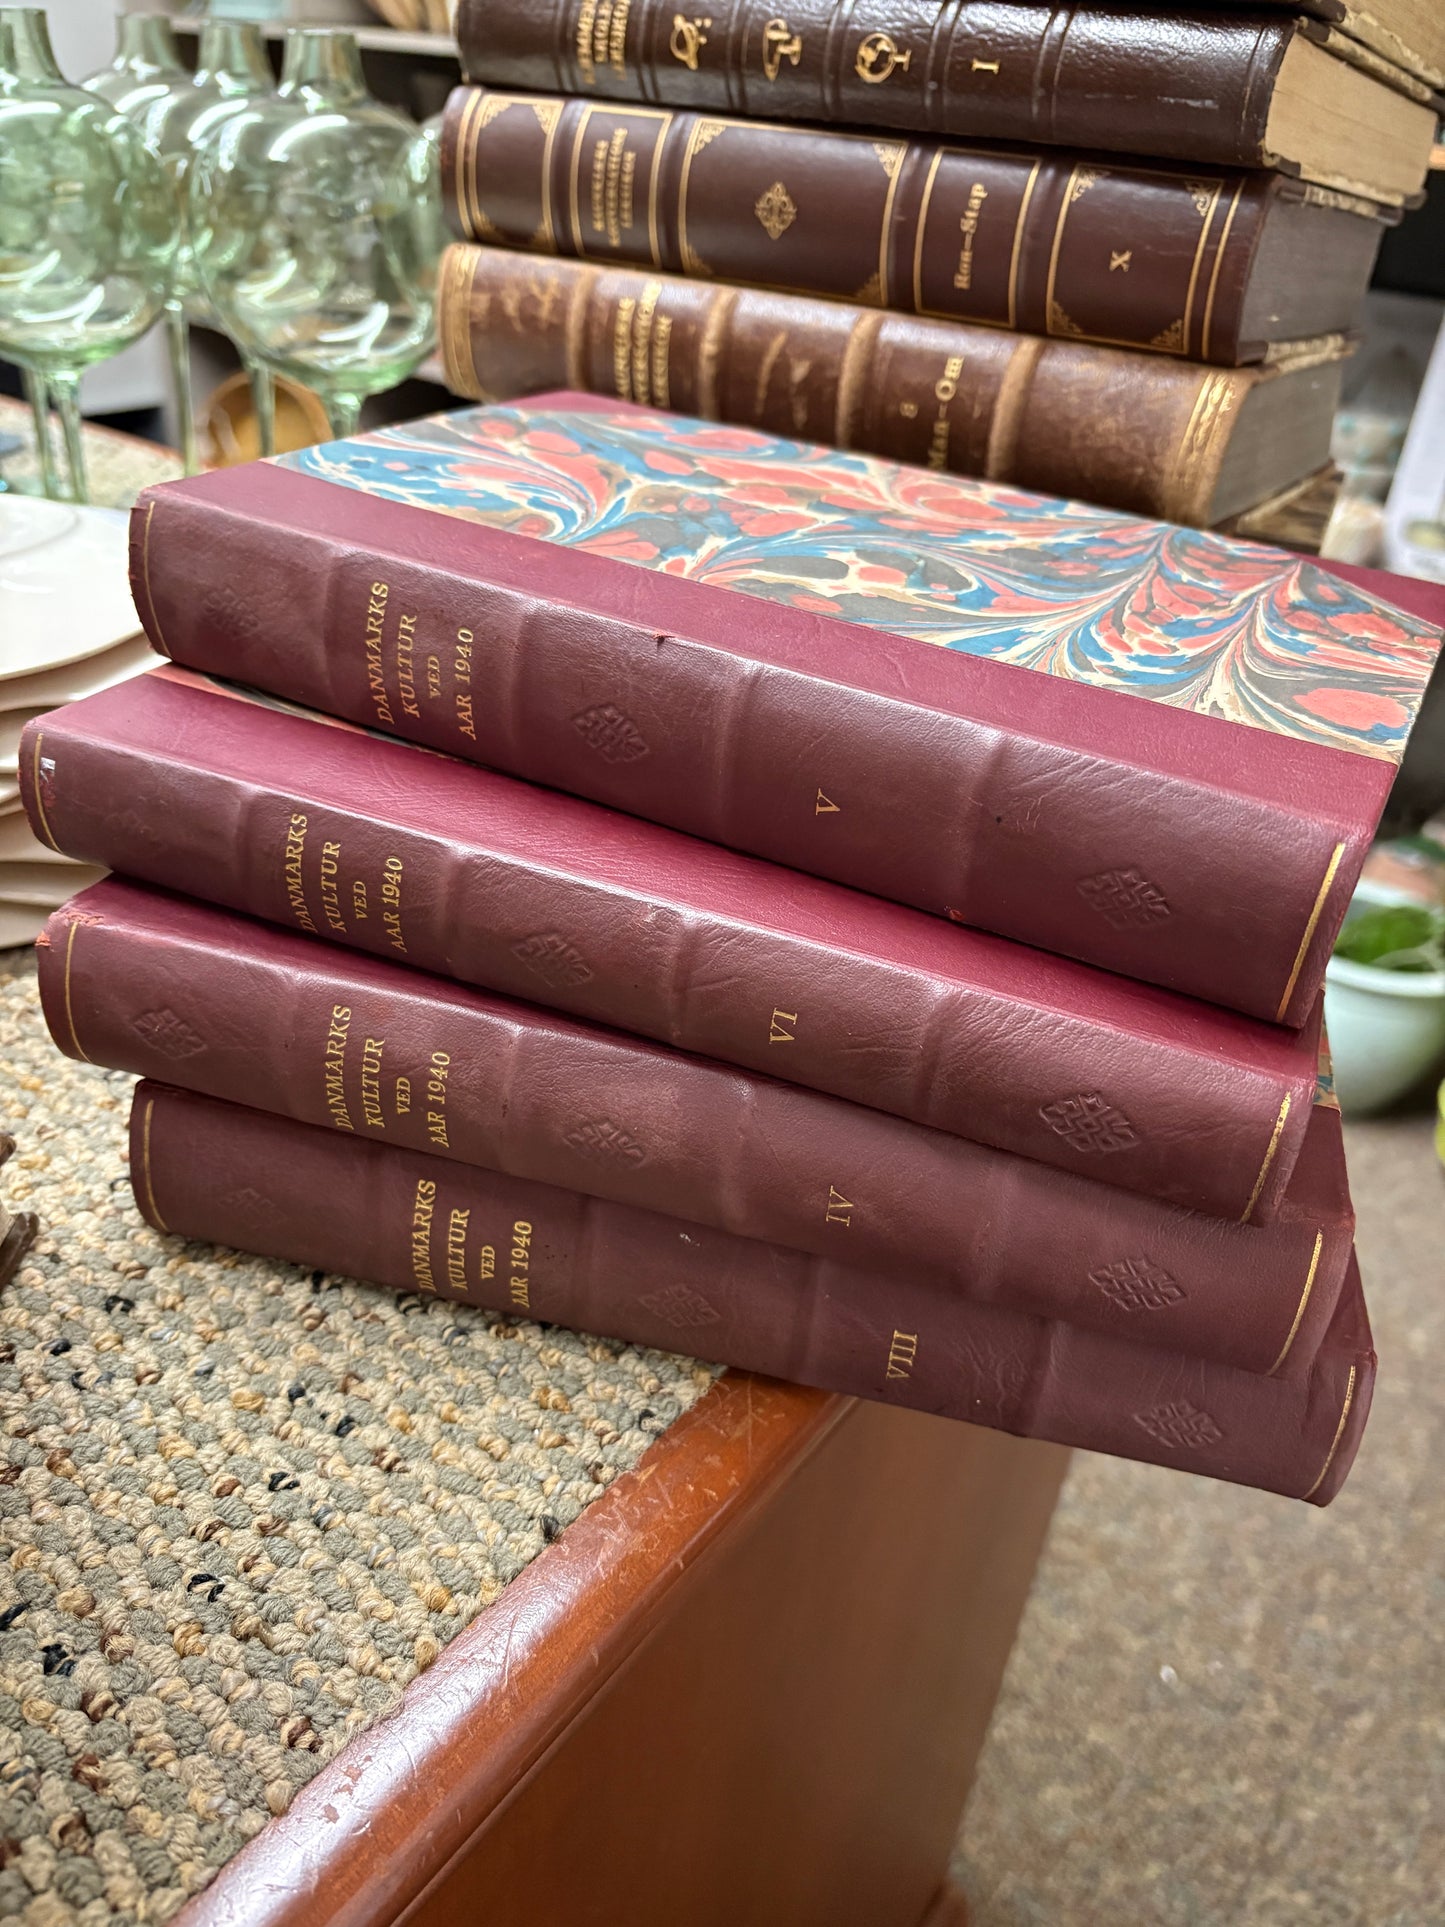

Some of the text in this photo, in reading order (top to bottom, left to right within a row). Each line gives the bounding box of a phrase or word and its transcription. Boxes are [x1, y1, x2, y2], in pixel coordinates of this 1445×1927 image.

[971, 58, 1000, 74] I
[365, 582, 395, 725] DANMARKS
[397, 614, 421, 719] KULTUR
[427, 654, 442, 700] VED
[454, 626, 477, 741] AAR 1940
[815, 787, 841, 816] V
[285, 813, 319, 934] DANMARKS
[320, 841, 348, 934] KULTUR
[353, 880, 369, 921] VED
[381, 856, 408, 954] AAR 1940
[324, 1004, 355, 1131] DANMARKS
[769, 1007, 798, 1045] VI
[361, 1037, 386, 1129] KULTUR
[396, 1076, 411, 1116] VED
[427, 1051, 451, 1149] AAR 1940
[411, 1179, 437, 1293] DANMARKS
[447, 1208, 471, 1291] KULTUR
[826, 1185, 855, 1228] IV
[480, 1245, 496, 1281] VED
[509, 1220, 533, 1309] AAR 1940
[885, 1329, 918, 1380] VIII
